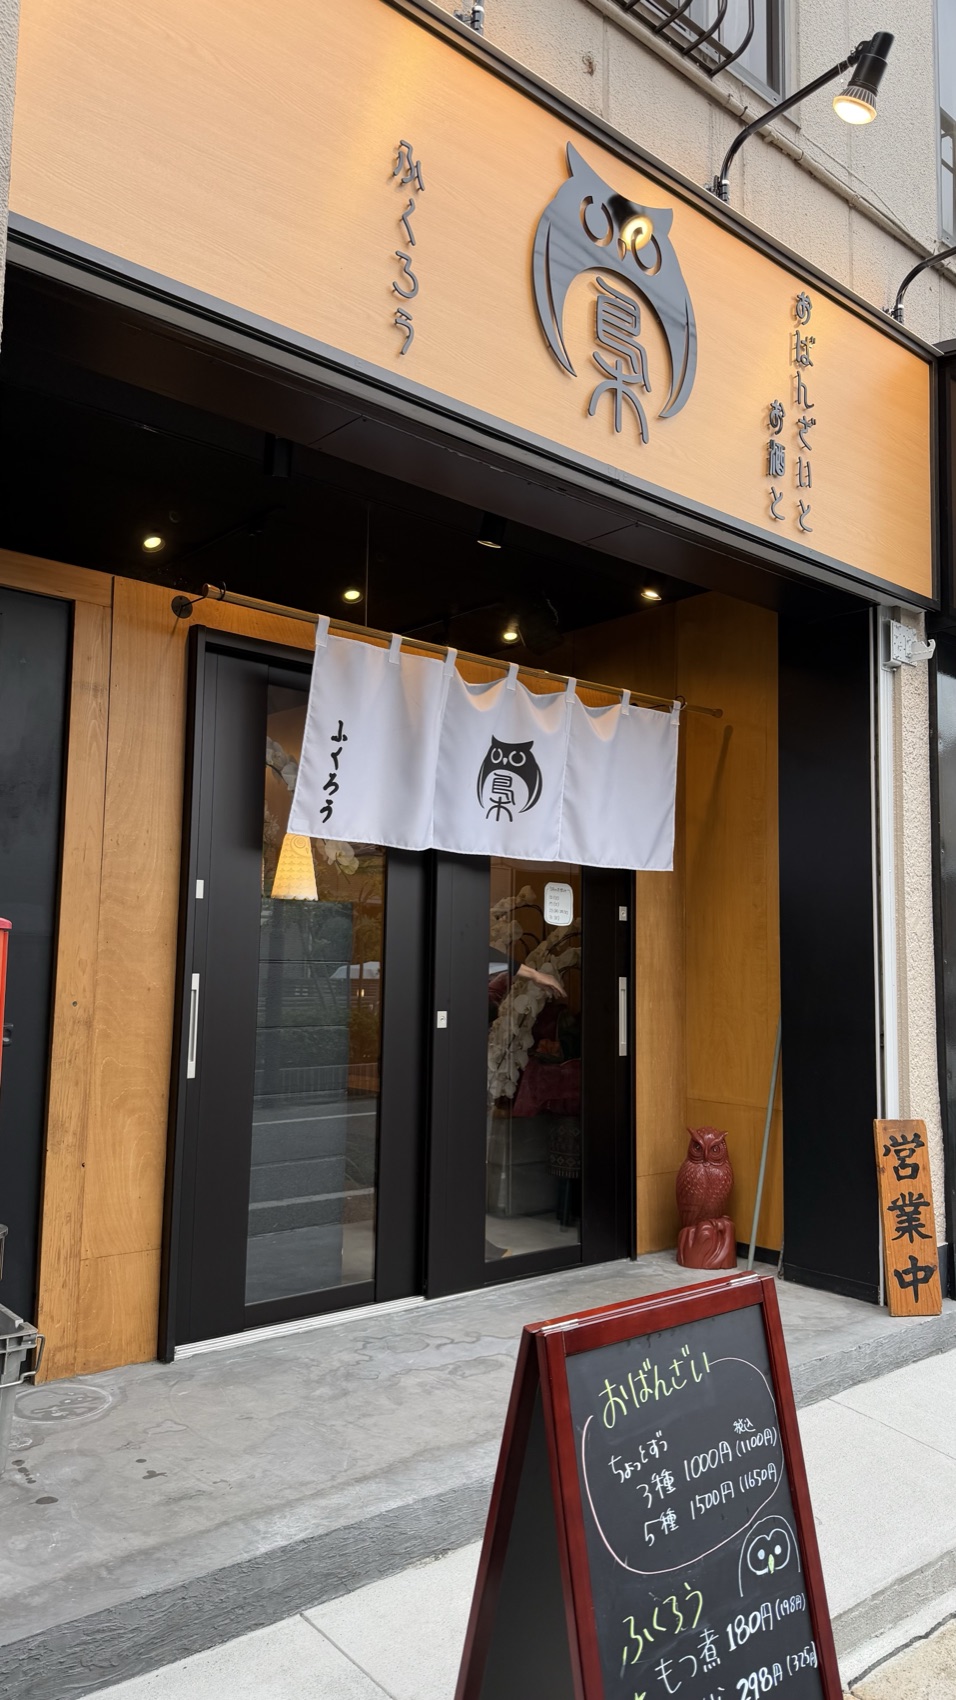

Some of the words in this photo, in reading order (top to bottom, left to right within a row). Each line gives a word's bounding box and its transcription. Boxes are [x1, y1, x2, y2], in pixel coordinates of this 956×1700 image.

[393, 139, 425, 355] ふくろう
[795, 292, 816, 533] おばんざいと
[768, 400, 786, 521] お酒と
[319, 720, 348, 824] ふくろう
[883, 1132, 937, 1304] 営業中
[598, 1344, 711, 1429] おばんざい
[733, 1417, 756, 1434] 税込
[608, 1430, 668, 1483] ちょっとずつ
[636, 1469, 677, 1509] 3種
[644, 1507, 680, 1547] 5種
[621, 1582, 704, 1666] ふくろう
[655, 1629, 721, 1694] もつ煮
